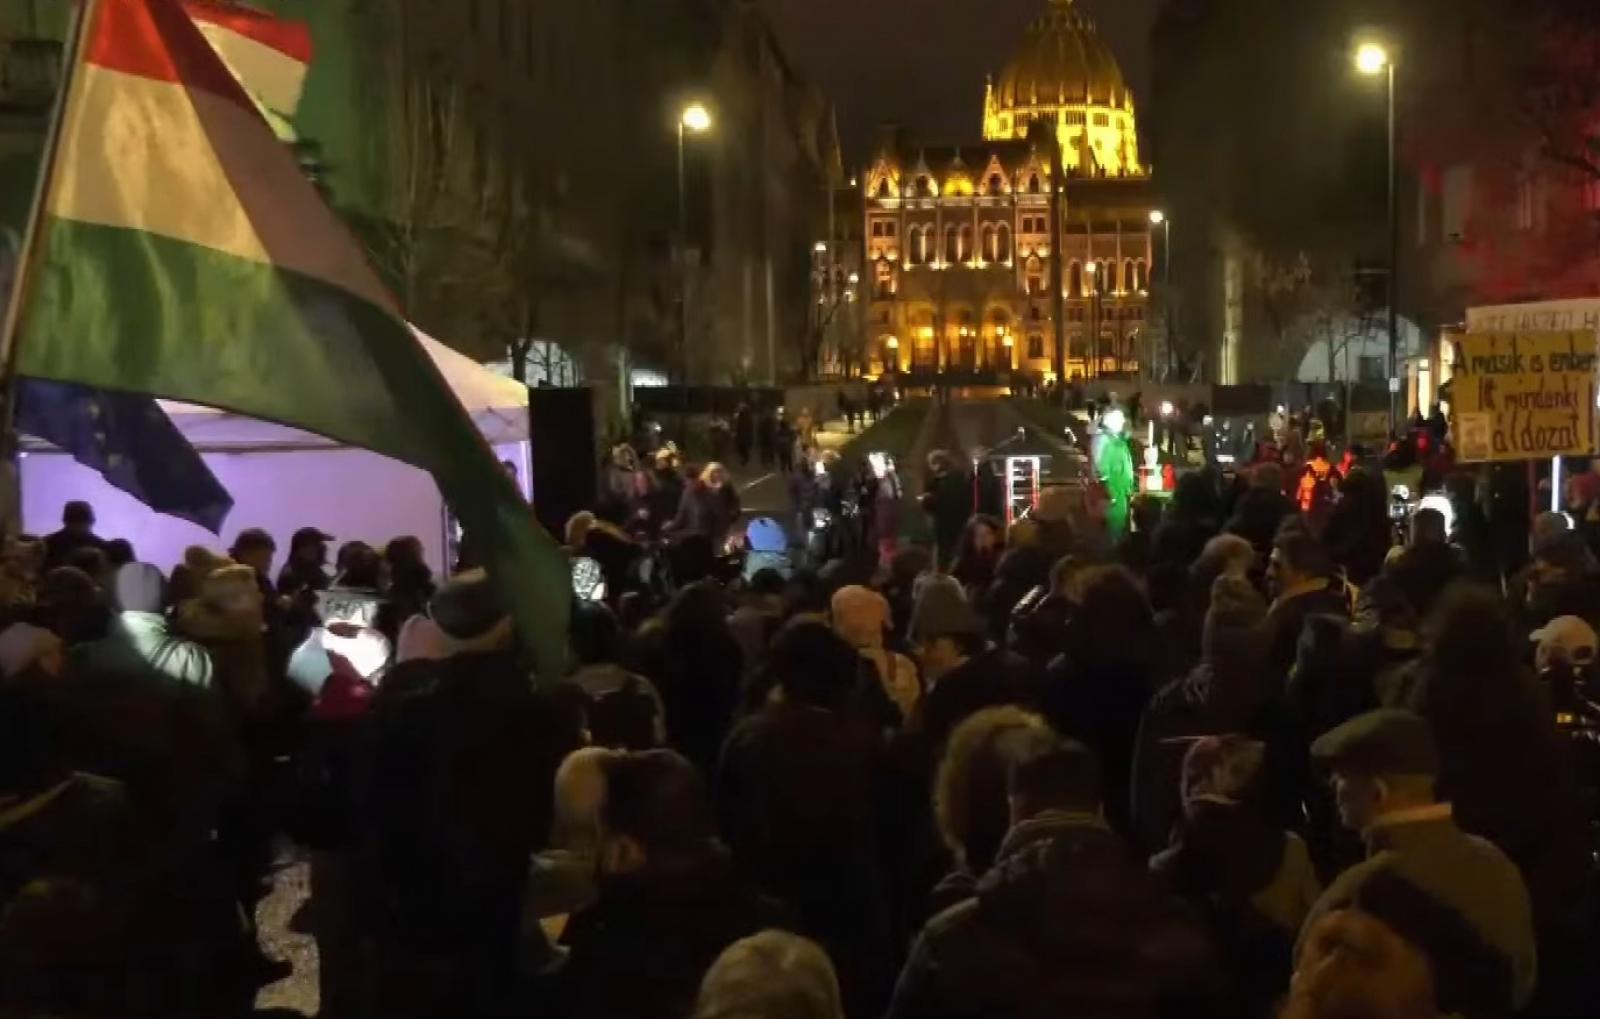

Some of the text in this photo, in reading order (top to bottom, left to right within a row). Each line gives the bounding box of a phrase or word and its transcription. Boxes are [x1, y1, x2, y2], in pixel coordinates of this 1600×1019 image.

[1453, 340, 1468, 378] A
[1471, 334, 1525, 375] másik
[1529, 338, 1543, 374] is
[1503, 375, 1579, 411] mindenki
